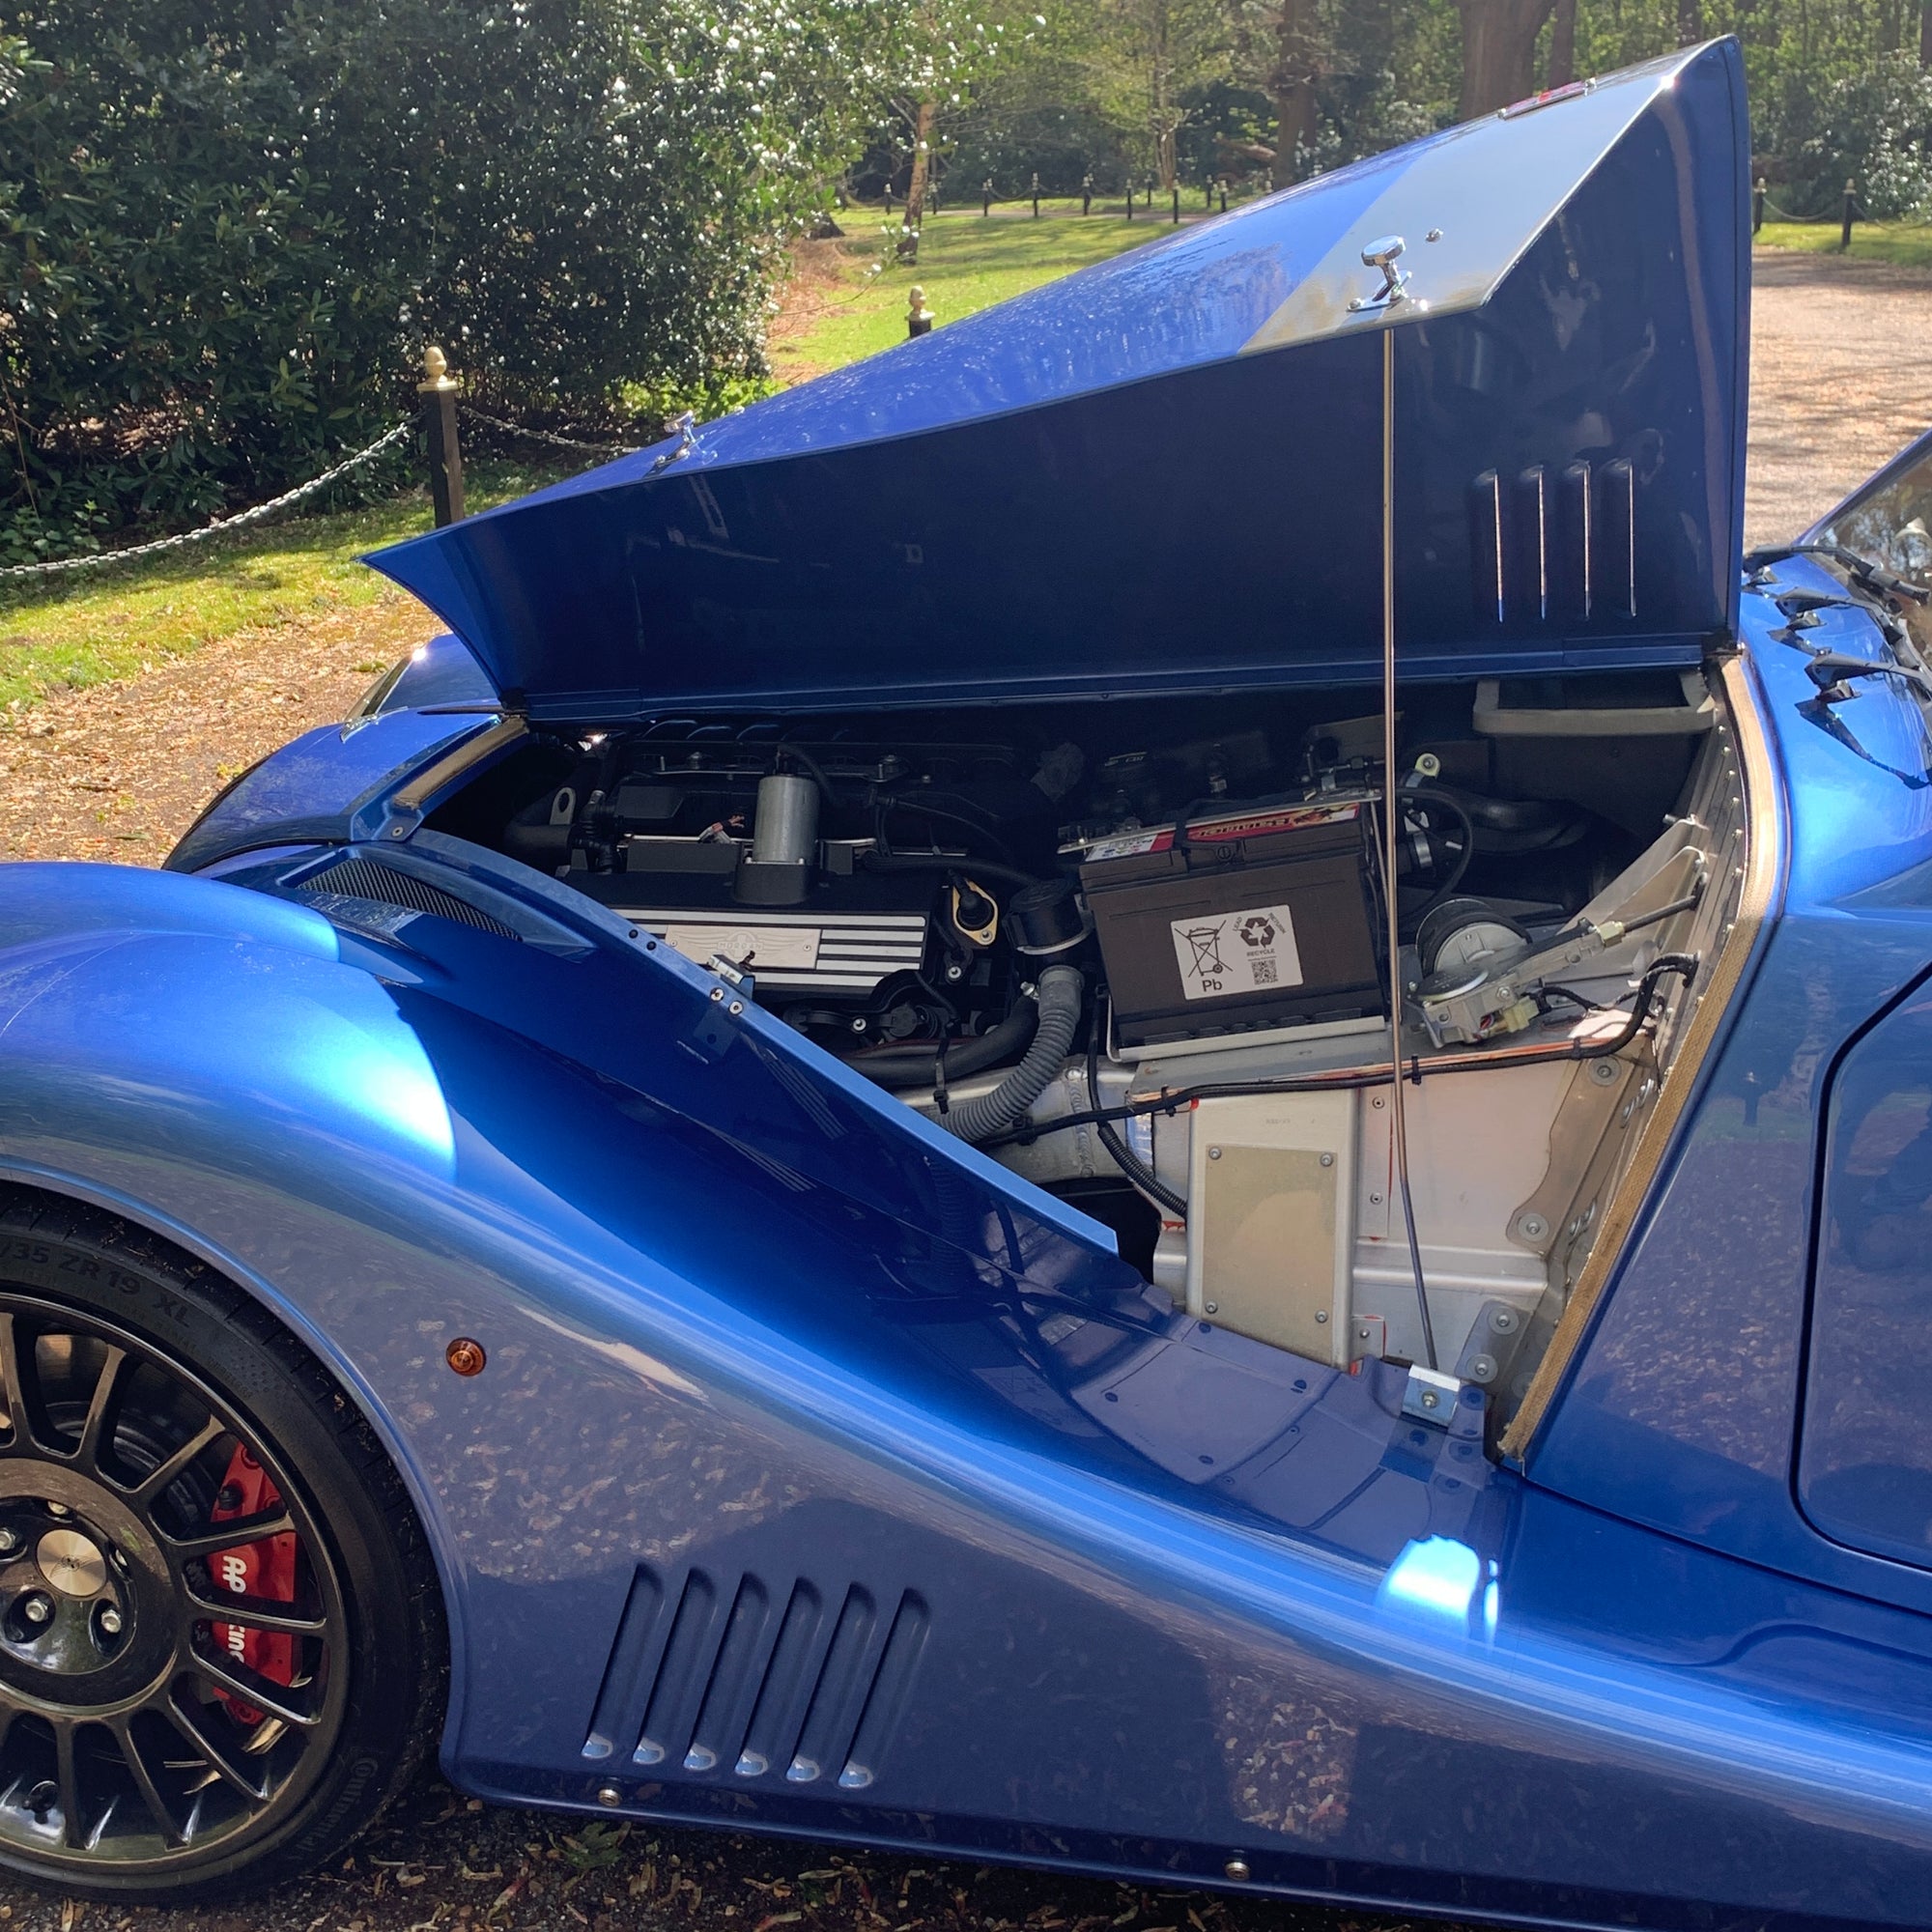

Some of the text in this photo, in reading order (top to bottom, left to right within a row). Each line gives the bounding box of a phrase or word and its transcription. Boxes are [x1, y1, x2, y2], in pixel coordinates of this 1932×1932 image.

[1246, 948, 1275, 957] RECYCLE
[1202, 978, 1223, 992] Pb
[59, 1253, 100, 1281] ZR
[108, 1271, 141, 1294] 19
[153, 1293, 190, 1327] XL
